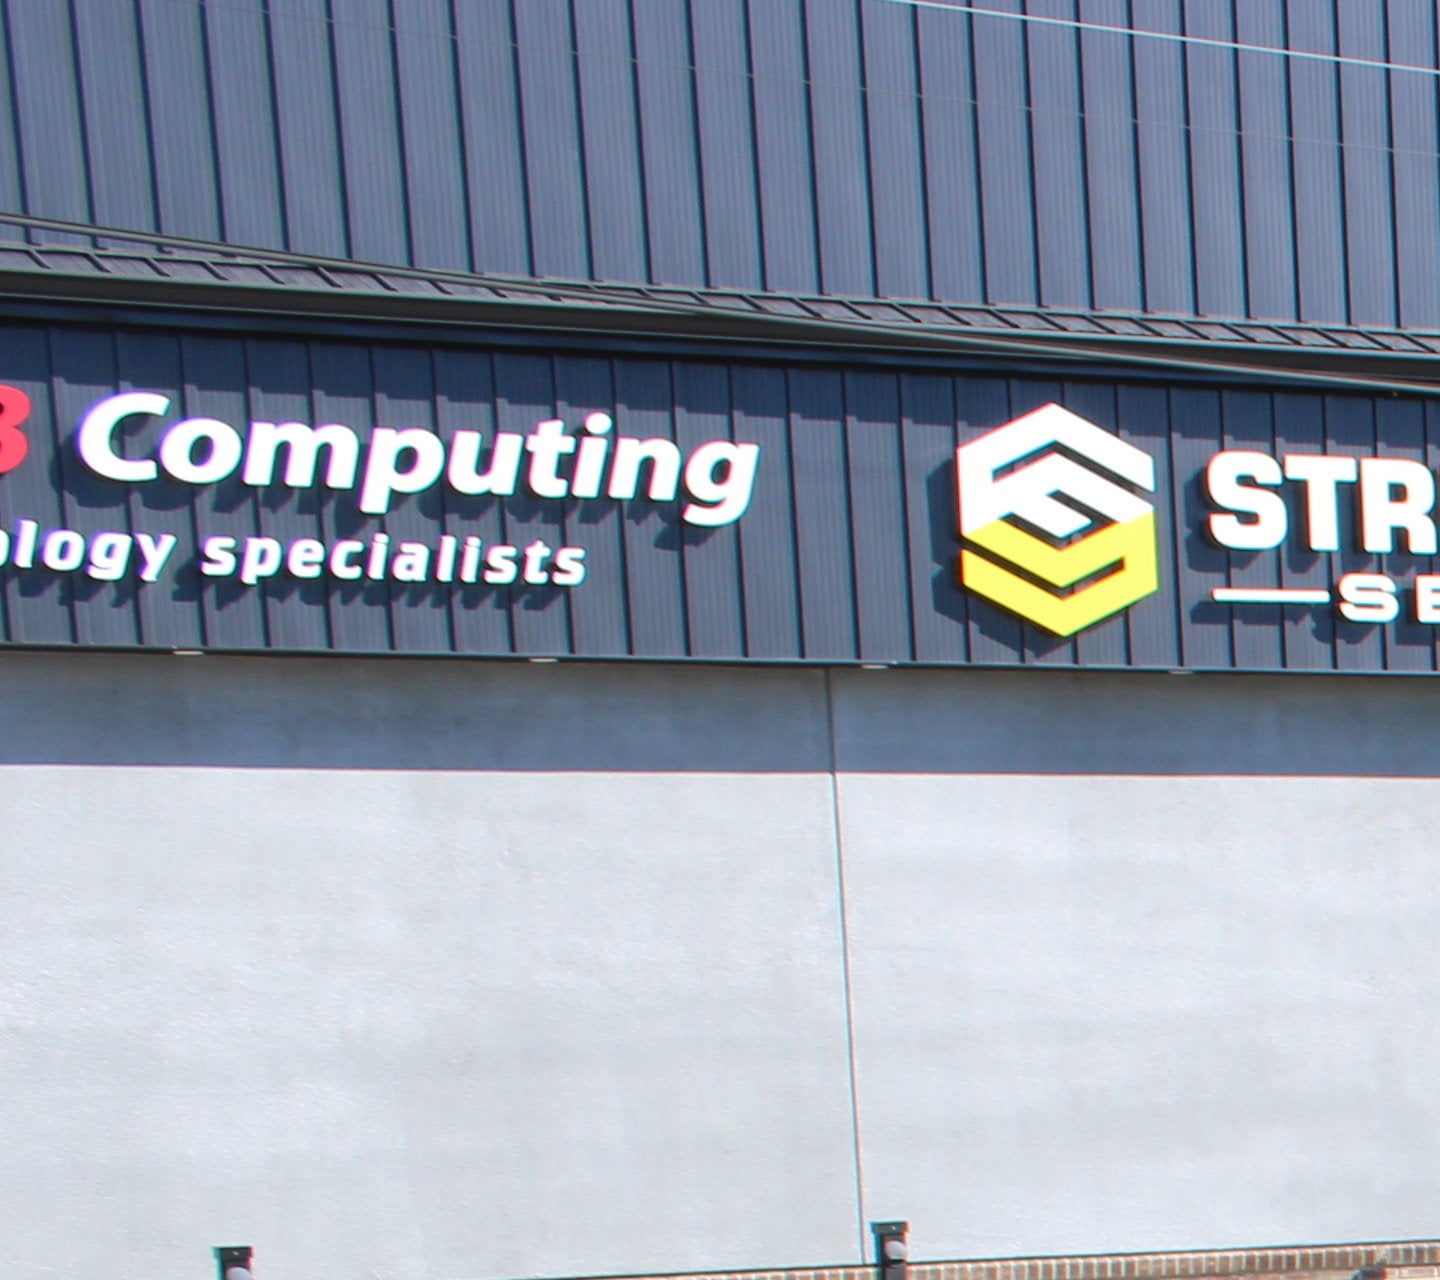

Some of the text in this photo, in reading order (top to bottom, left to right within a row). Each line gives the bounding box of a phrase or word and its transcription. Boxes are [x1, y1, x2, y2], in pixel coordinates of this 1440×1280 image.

[79, 391, 759, 527] Computing
[0, 518, 586, 585] logy specialists
